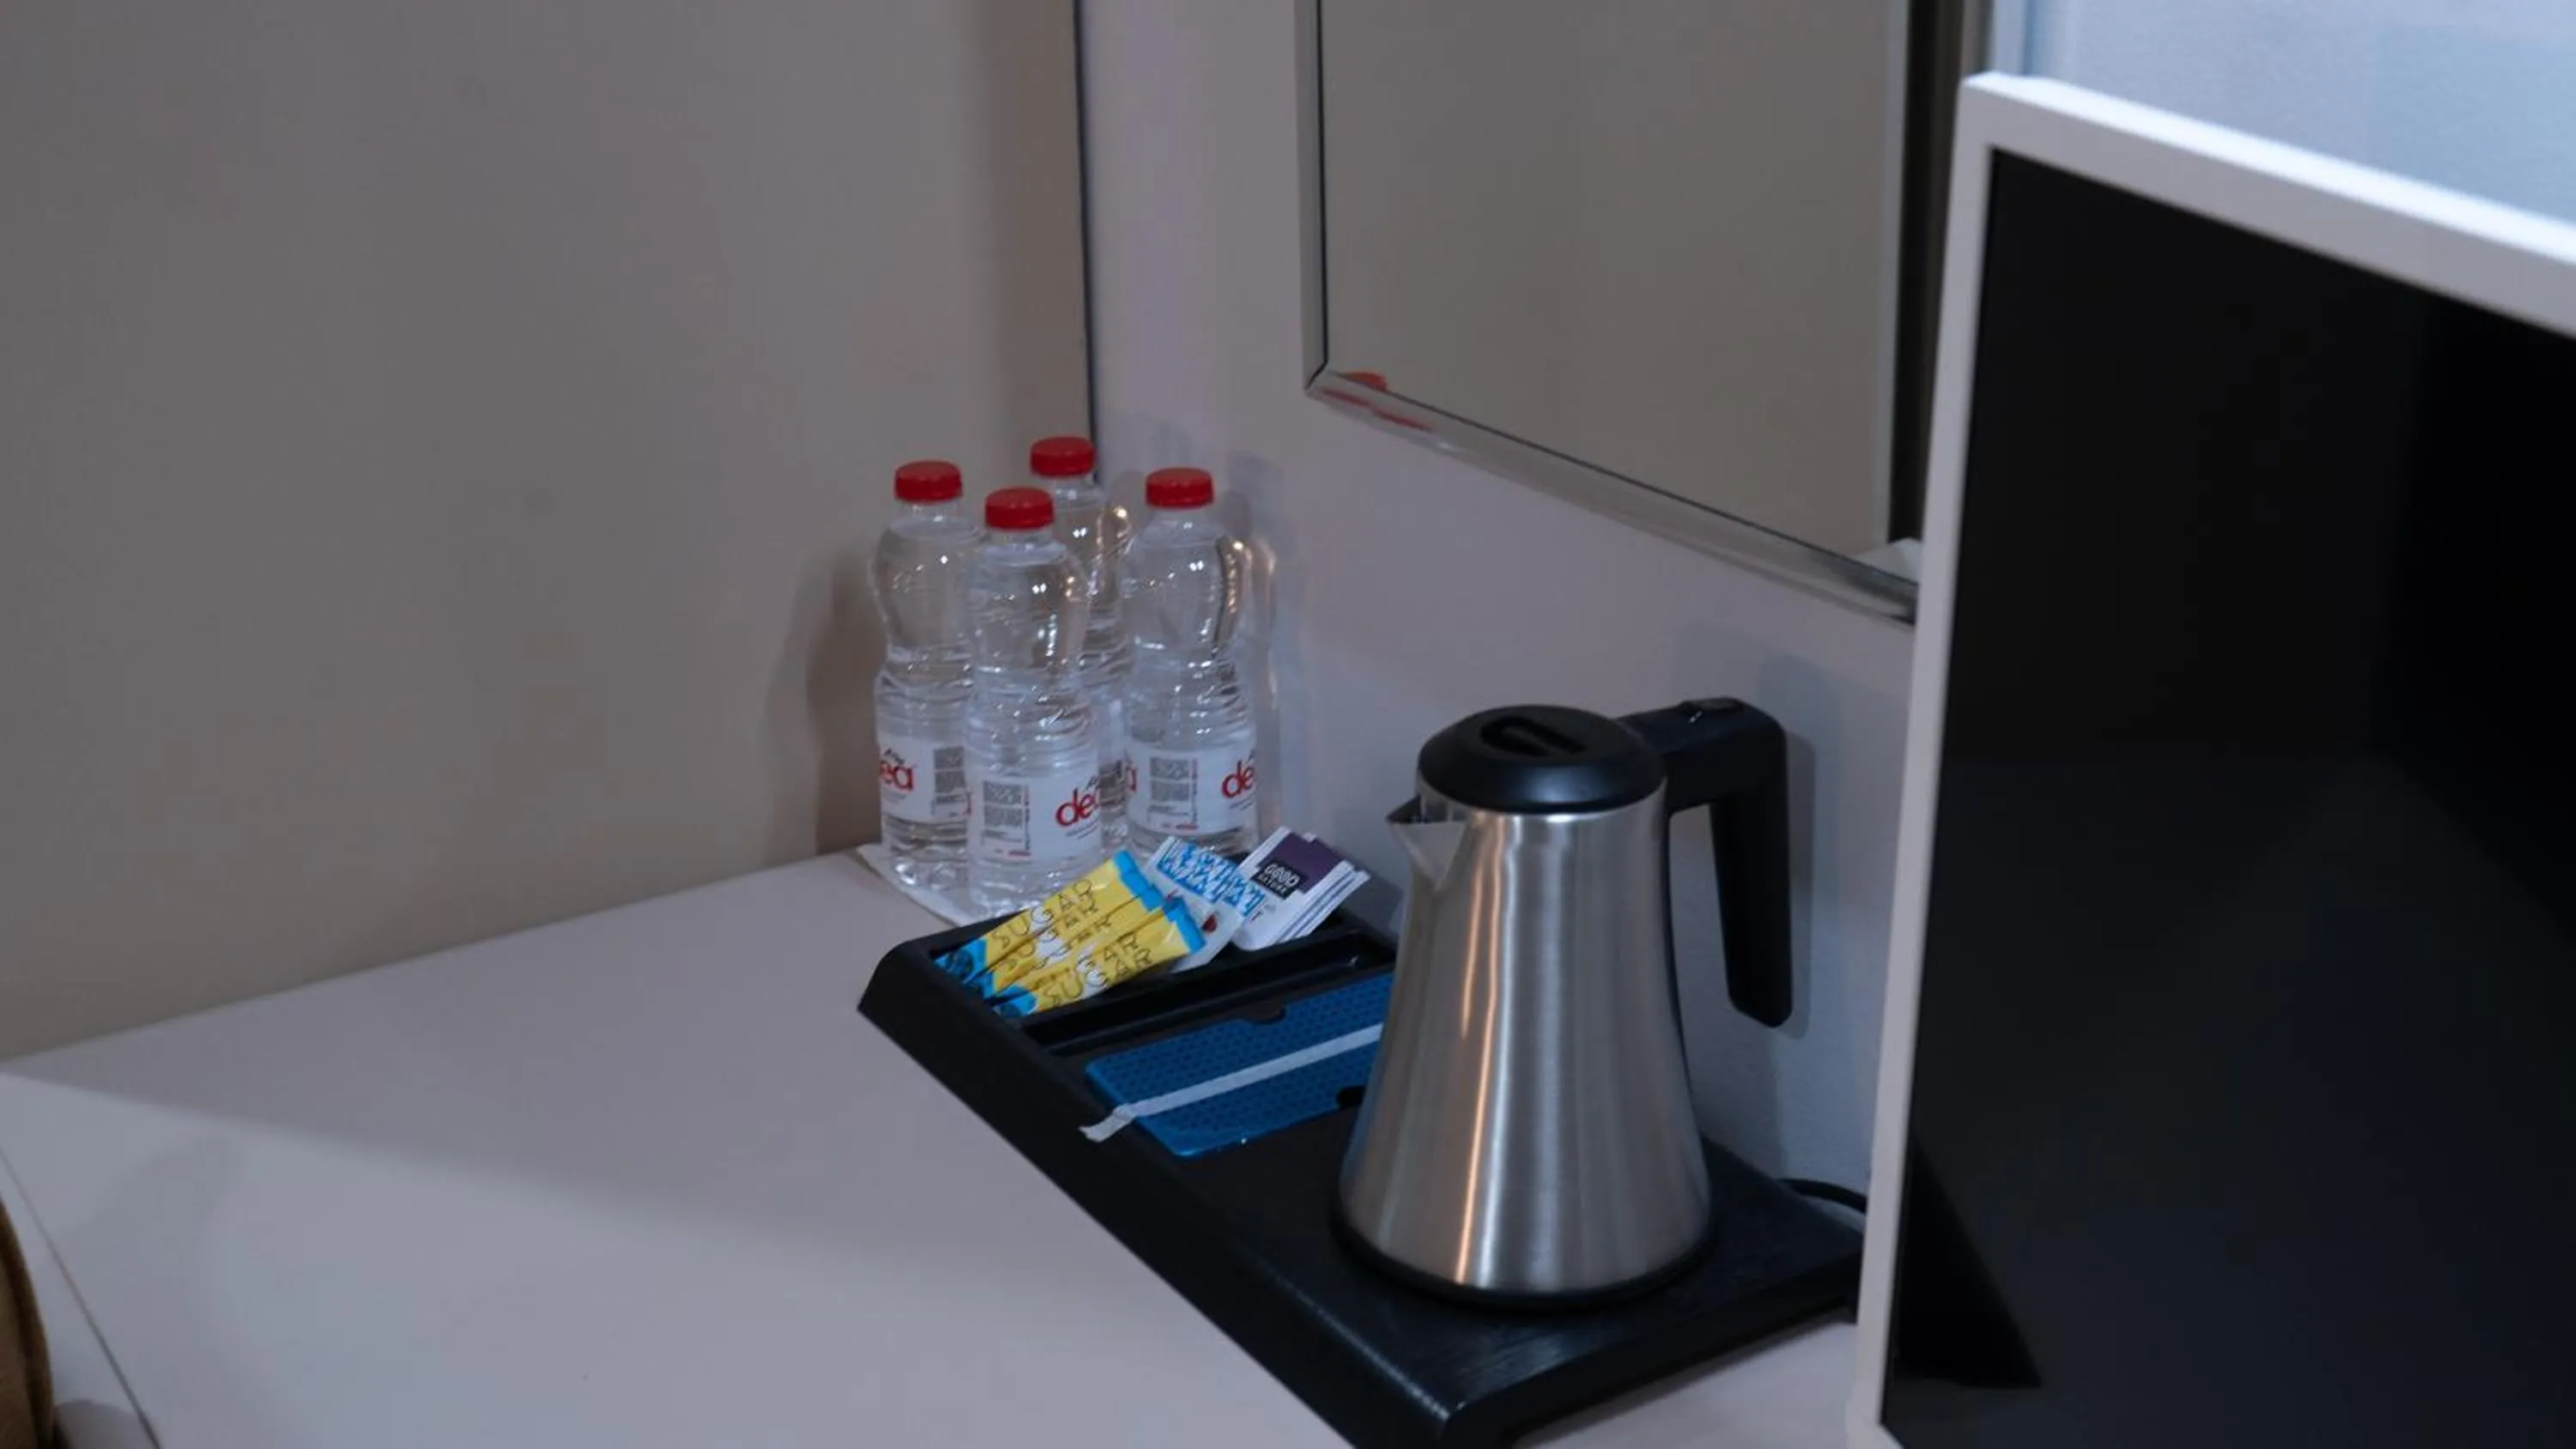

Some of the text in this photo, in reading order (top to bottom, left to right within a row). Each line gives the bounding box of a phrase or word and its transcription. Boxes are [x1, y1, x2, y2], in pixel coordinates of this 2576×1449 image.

[880, 760, 914, 791] ea
[1222, 760, 1255, 797] de
[1055, 788, 1099, 827] de
[993, 879, 1093, 949] SUGAR
[1043, 948, 1152, 1007] SUGAR
